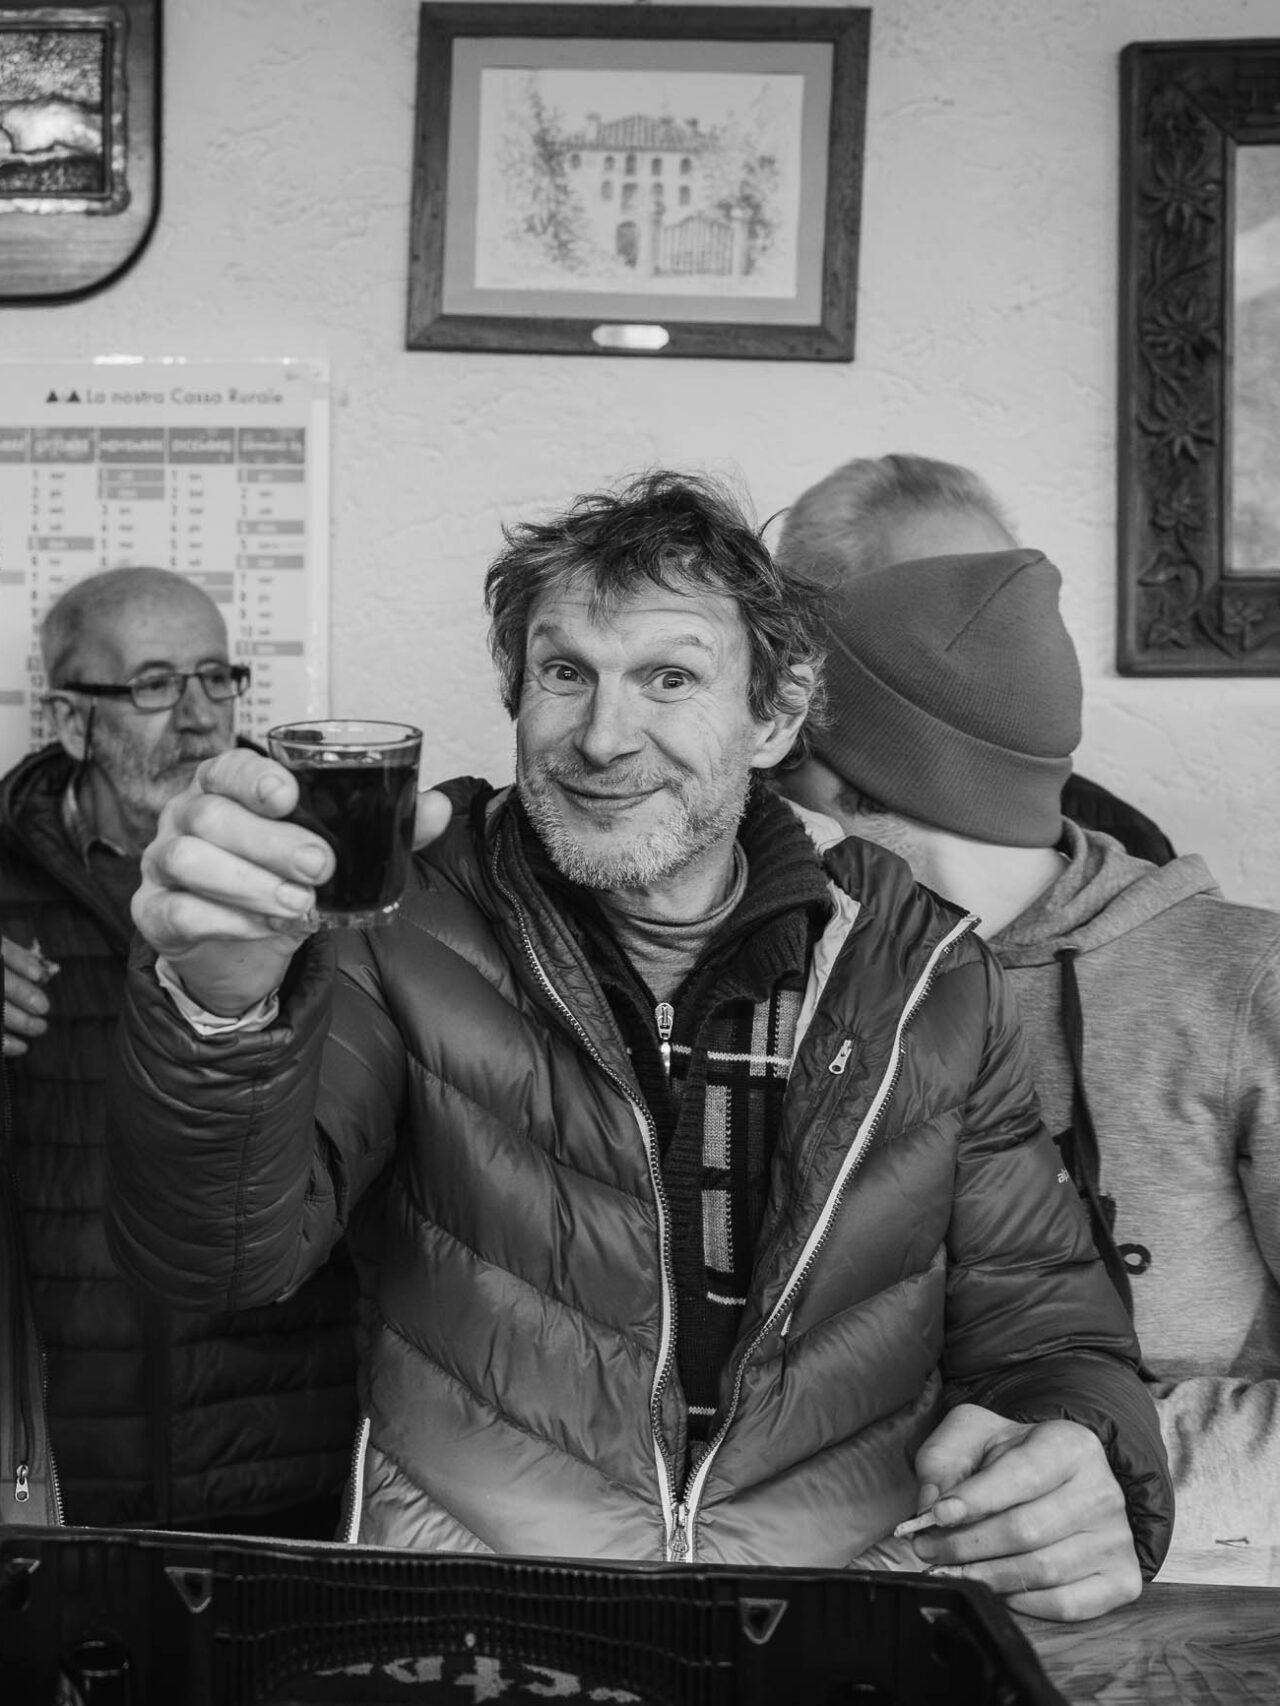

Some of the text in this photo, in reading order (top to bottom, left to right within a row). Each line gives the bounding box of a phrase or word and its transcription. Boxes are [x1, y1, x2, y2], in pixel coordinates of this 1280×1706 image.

[86, 388, 106, 404] La
[111, 391, 165, 404] nostra
[170, 387, 223, 404] Cassa
